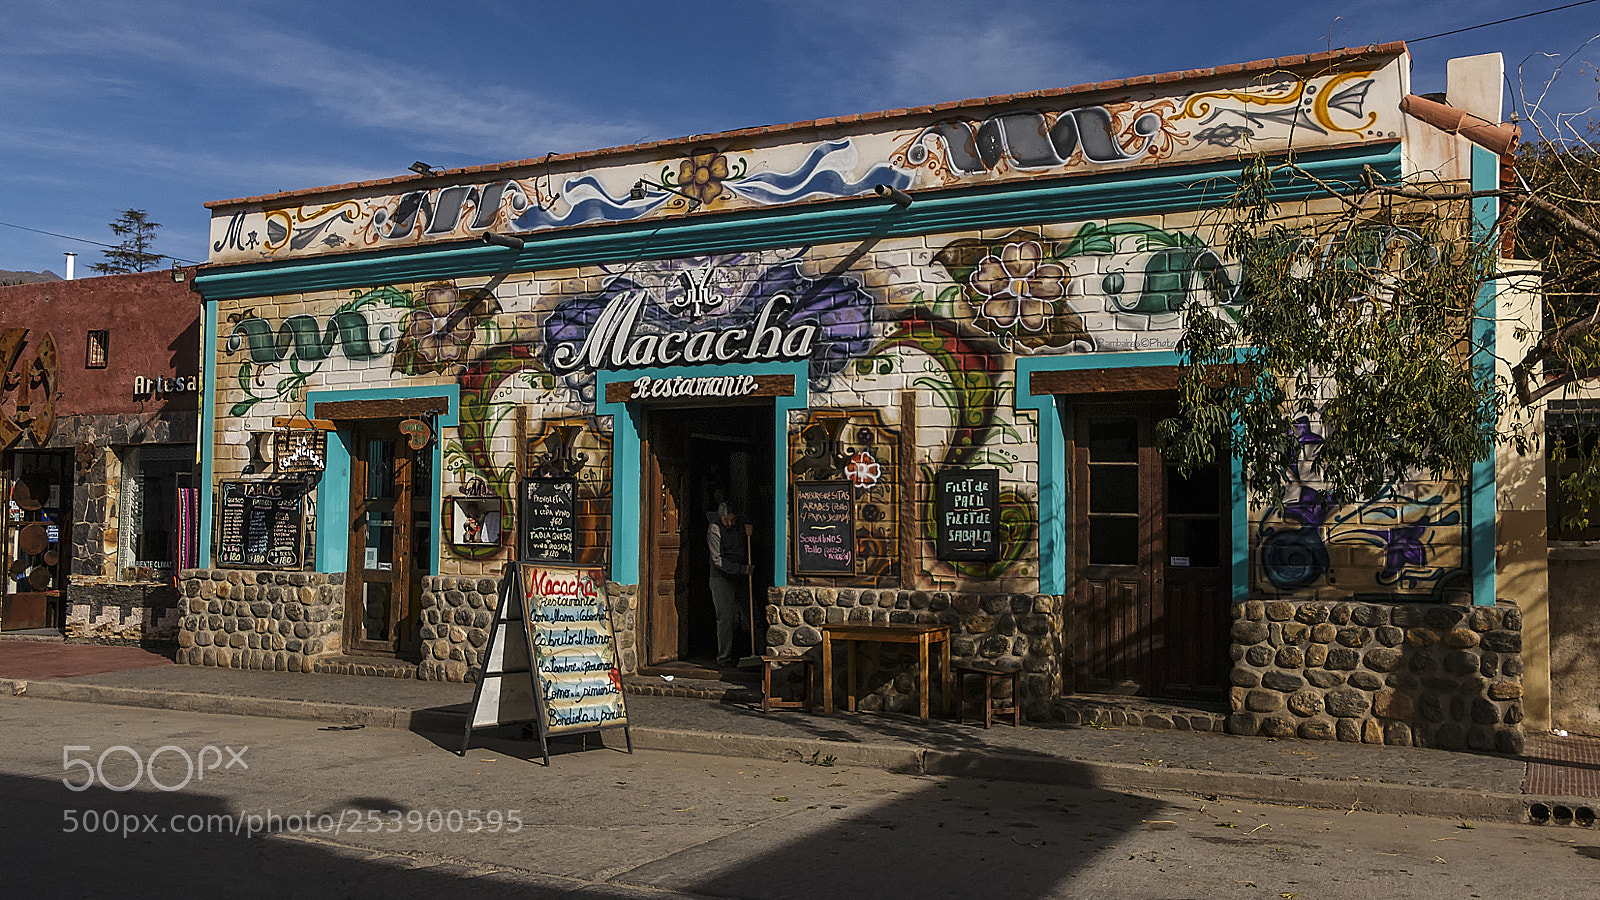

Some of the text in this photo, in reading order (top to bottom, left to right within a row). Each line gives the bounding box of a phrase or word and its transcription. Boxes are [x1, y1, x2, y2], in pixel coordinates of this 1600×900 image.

[553, 289, 817, 369] Macacha
[134, 374, 197, 395] Artesa
[631, 374, 759, 399] Restaurante
[405, 424, 425, 432] WINE
[296, 436, 308, 447] LA
[413, 435, 427, 445] BAR
[243, 483, 282, 497] TABLAS
[945, 478, 974, 493] FILET
[533, 494, 565, 504] PROVOLETA
[539, 508, 554, 516] COPA
[554, 508, 571, 518] VINO
[945, 511, 977, 527] FILET
[549, 516, 563, 527] $60
[529, 531, 552, 540] TABLA
[947, 529, 992, 547] SABALO
[525, 568, 597, 598] Macacha
[538, 596, 598, 609] Restaurante
[534, 626, 577, 647] Cabrito
[583, 627, 612, 646] horno
[543, 680, 571, 701] Lomo
[575, 678, 620, 703] pimienta
[547, 708, 590, 727] Bondiola
